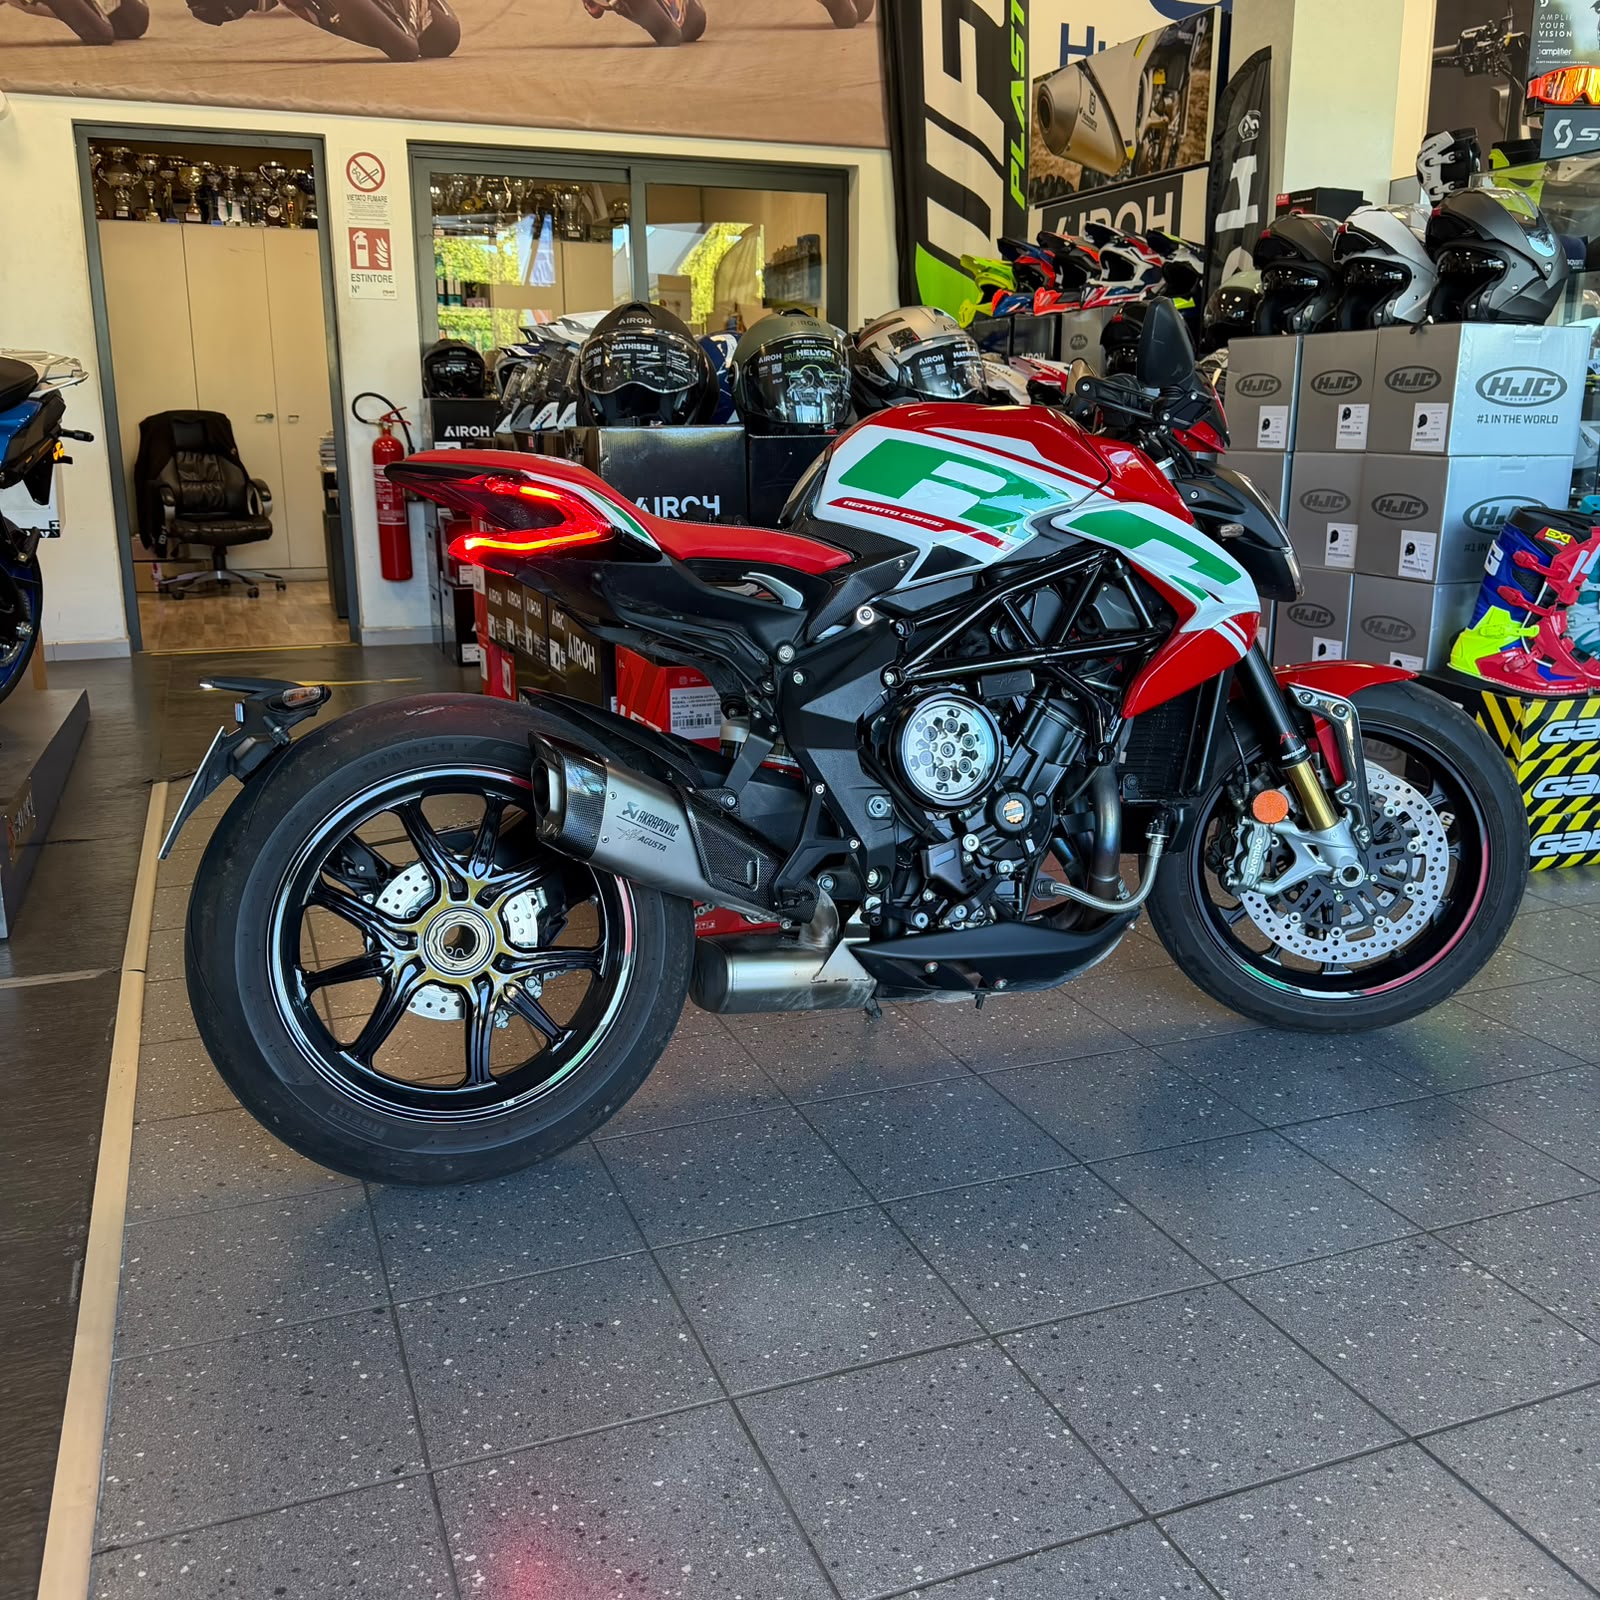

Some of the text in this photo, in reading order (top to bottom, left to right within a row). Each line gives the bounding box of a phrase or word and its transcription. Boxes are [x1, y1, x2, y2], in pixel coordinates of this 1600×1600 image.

[1540, 22, 1565, 30] YOUR
[1575, 127, 1600, 141] S
[346, 193, 388, 203] VIETATO FUMARE
[351, 273, 394, 284] ESTINTORE
[618, 317, 653, 326] AIROH
[611, 343, 652, 352] MATHISSE
[796, 349, 832, 358] HELYOS
[758, 353, 782, 364] AIROH
[919, 354, 944, 366] AIROH
[1241, 378, 1276, 392] HJC
[1316, 375, 1356, 390] HJC
[1391, 372, 1435, 387] HJC
[1486, 376, 1557, 397] HJC
[1476, 414, 1559, 425] #1 IN THE WORLD
[444, 425, 490, 437] AIROH
[1304, 494, 1345, 510] HJC
[1375, 499, 1422, 516] HJC
[526, 596, 542, 619] AIROH
[1292, 607, 1329, 624] HJC
[1367, 620, 1409, 638] HJC
[567, 632, 596, 675] AIROH
[637, 835, 667, 852] AGUSTA
[1247, 837, 1264, 874] brembo
